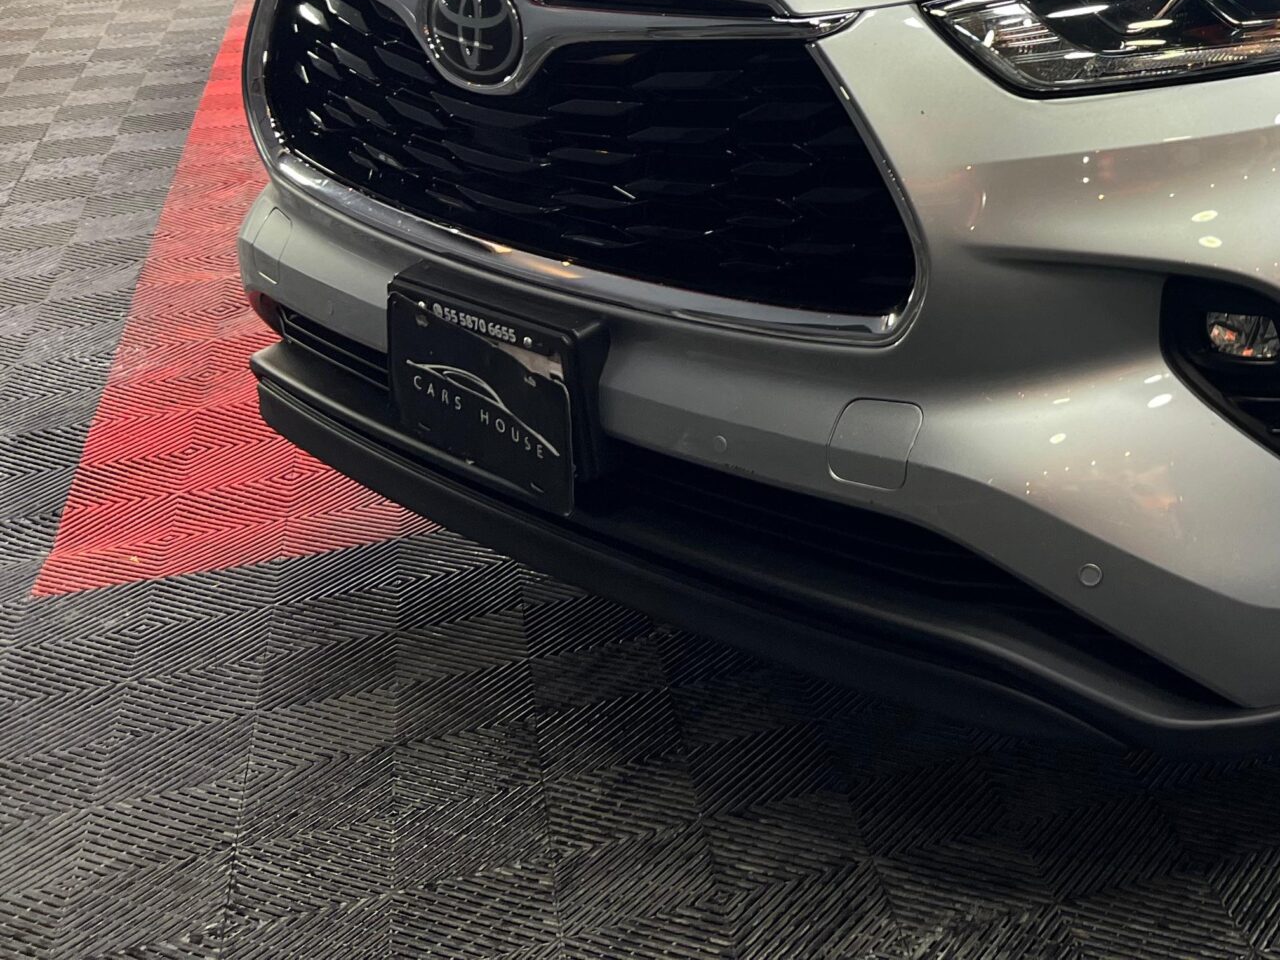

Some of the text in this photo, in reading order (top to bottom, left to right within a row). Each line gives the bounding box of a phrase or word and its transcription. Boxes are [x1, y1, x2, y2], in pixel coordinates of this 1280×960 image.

[443, 307, 517, 343] 55 5870 6655
[413, 375, 544, 459] CARS HOUSE
